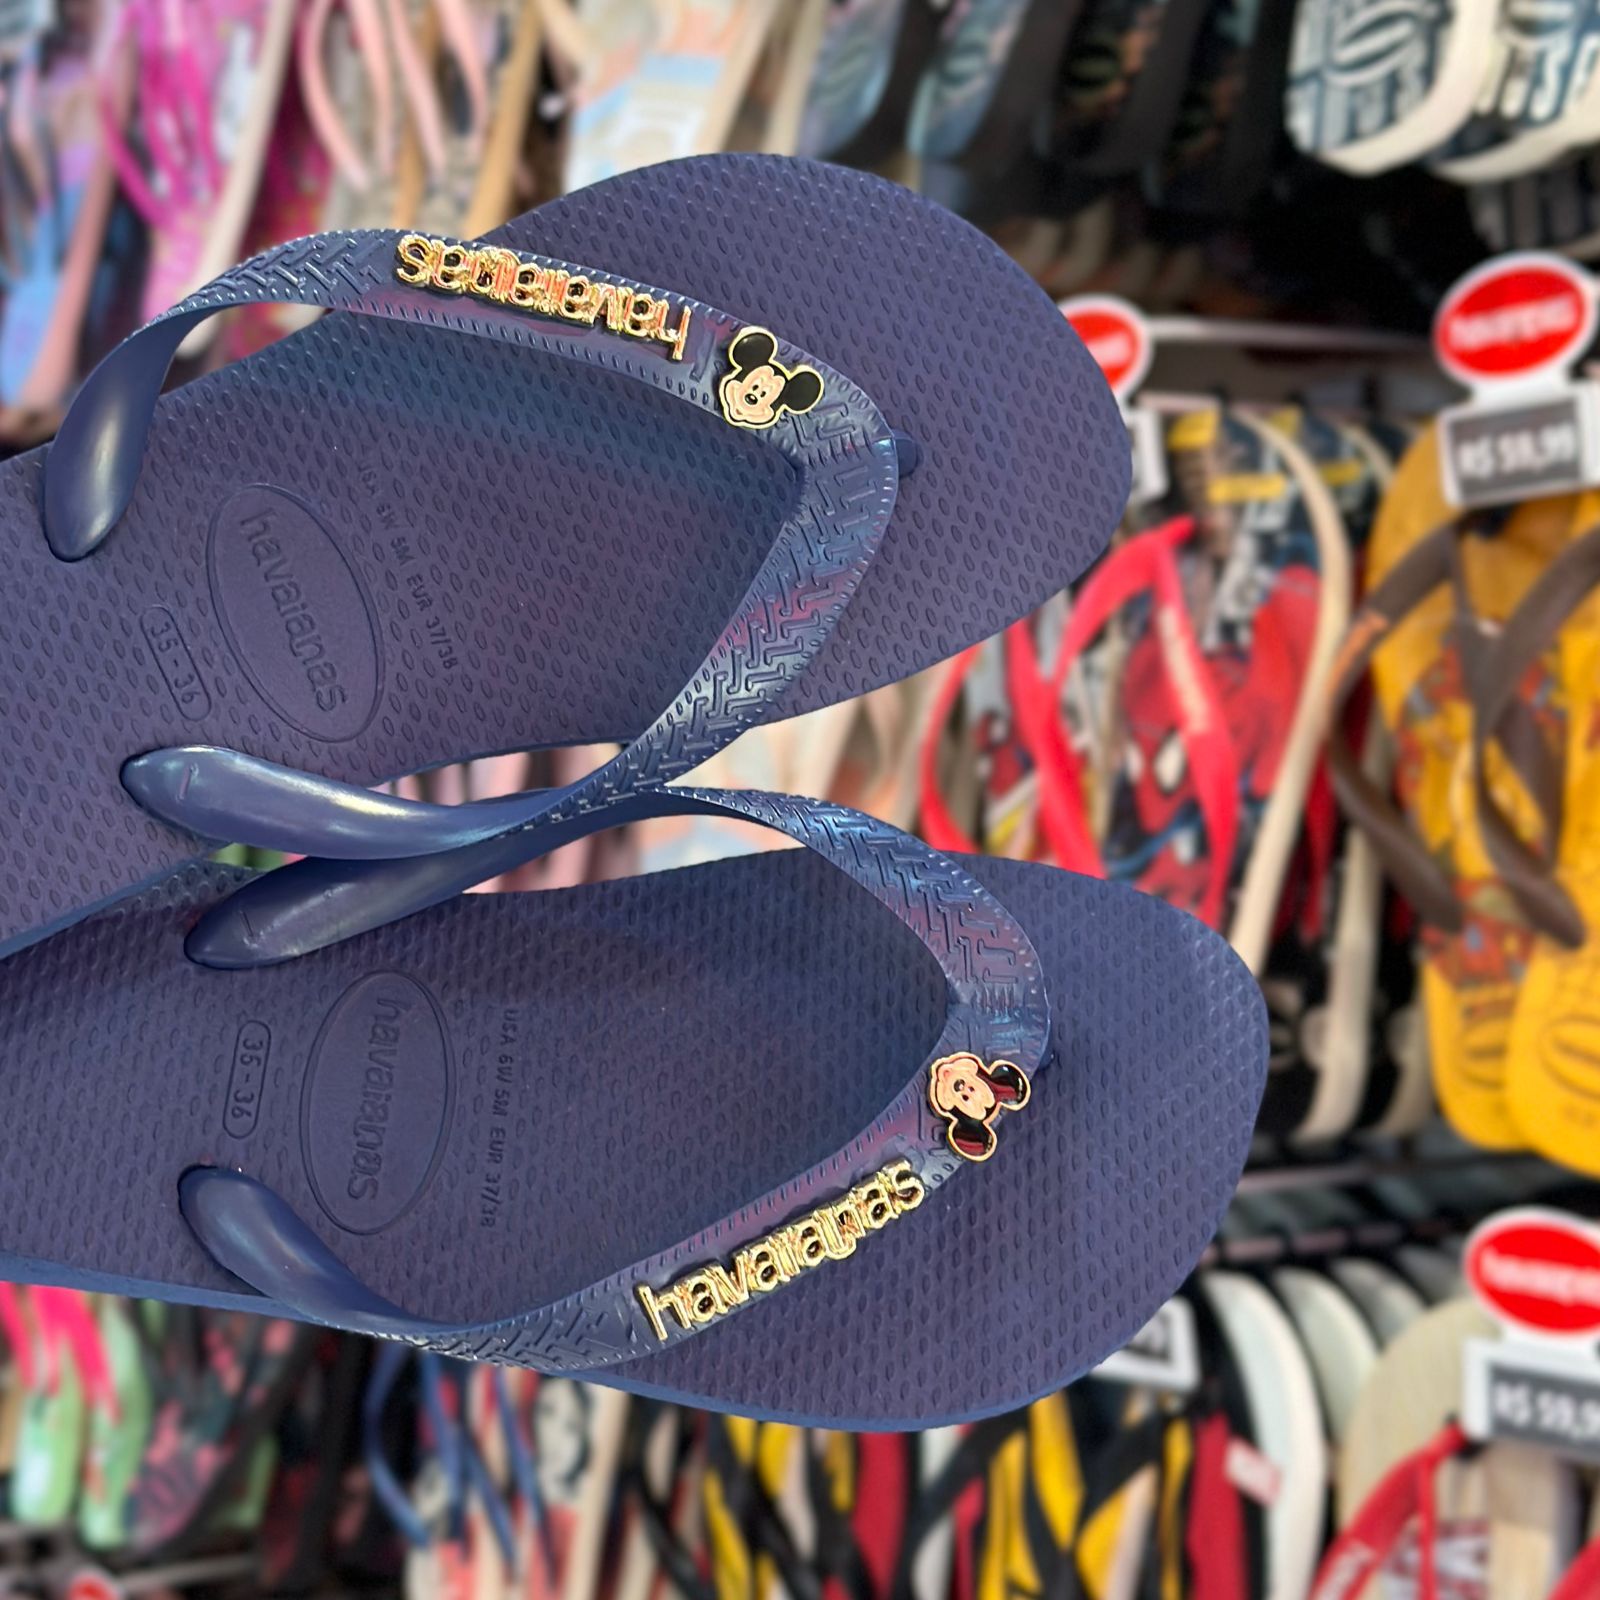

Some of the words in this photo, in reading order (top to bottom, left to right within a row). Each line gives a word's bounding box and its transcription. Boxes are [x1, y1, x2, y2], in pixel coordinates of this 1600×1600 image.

[396, 233, 692, 361] havaianas
[240, 507, 347, 713] havaianas
[407, 573, 432, 612] EUR
[426, 616, 459, 670] 37/38
[502, 1008, 519, 1045] USA
[346, 997, 413, 1201] havaianas
[487, 1126, 506, 1164] EUR
[480, 1172, 501, 1229] 37/38
[634, 1158, 926, 1342] havaianas
